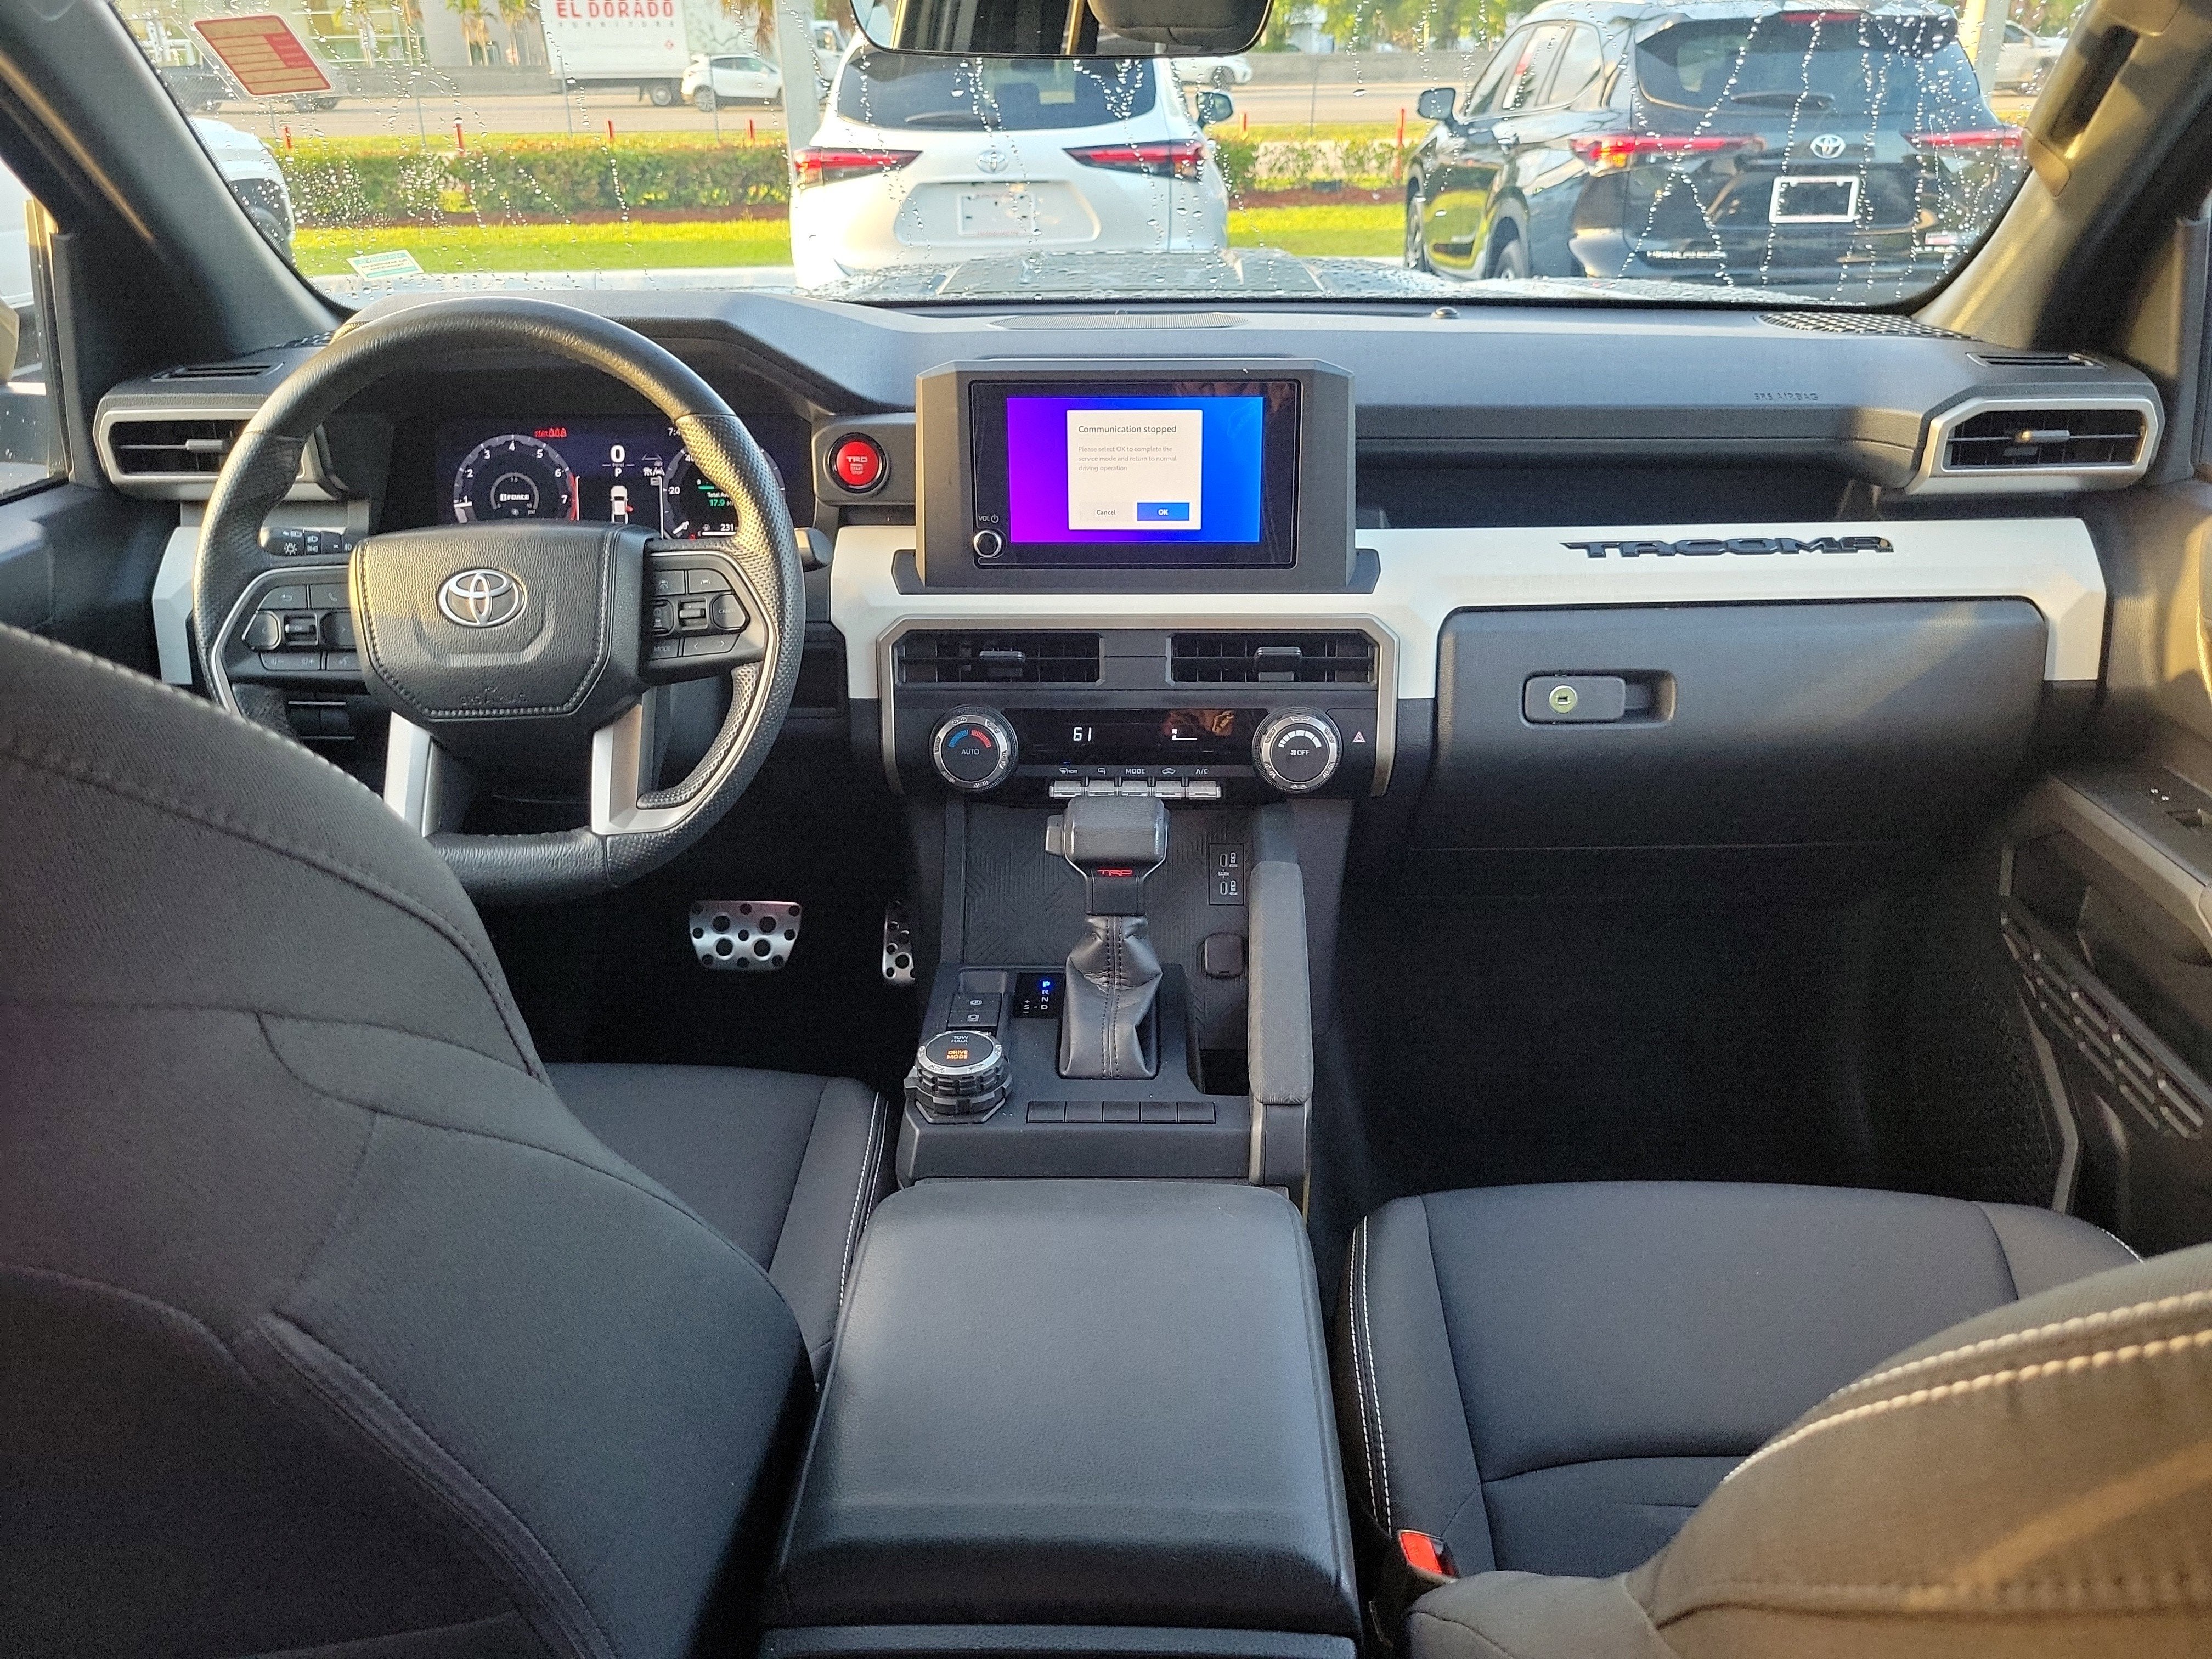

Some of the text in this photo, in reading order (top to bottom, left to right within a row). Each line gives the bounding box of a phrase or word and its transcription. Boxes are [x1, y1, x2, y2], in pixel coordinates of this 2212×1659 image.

[557, 1, 673, 18] EL DORADO
[1143, 425, 1177, 435] stopped
[509, 442, 516, 452] 4
[484, 449, 491, 459] 3
[536, 449, 543, 459] 5
[610, 444, 625, 463] 0
[467, 469, 473, 478] 2
[555, 468, 562, 478] 6
[614, 467, 622, 477] P
[669, 486, 680, 495] 20
[463, 495, 468, 503] 1
[561, 494, 568, 504] 7
[1559, 535, 1894, 558] TACOMA
[1073, 727, 1092, 741] 61
